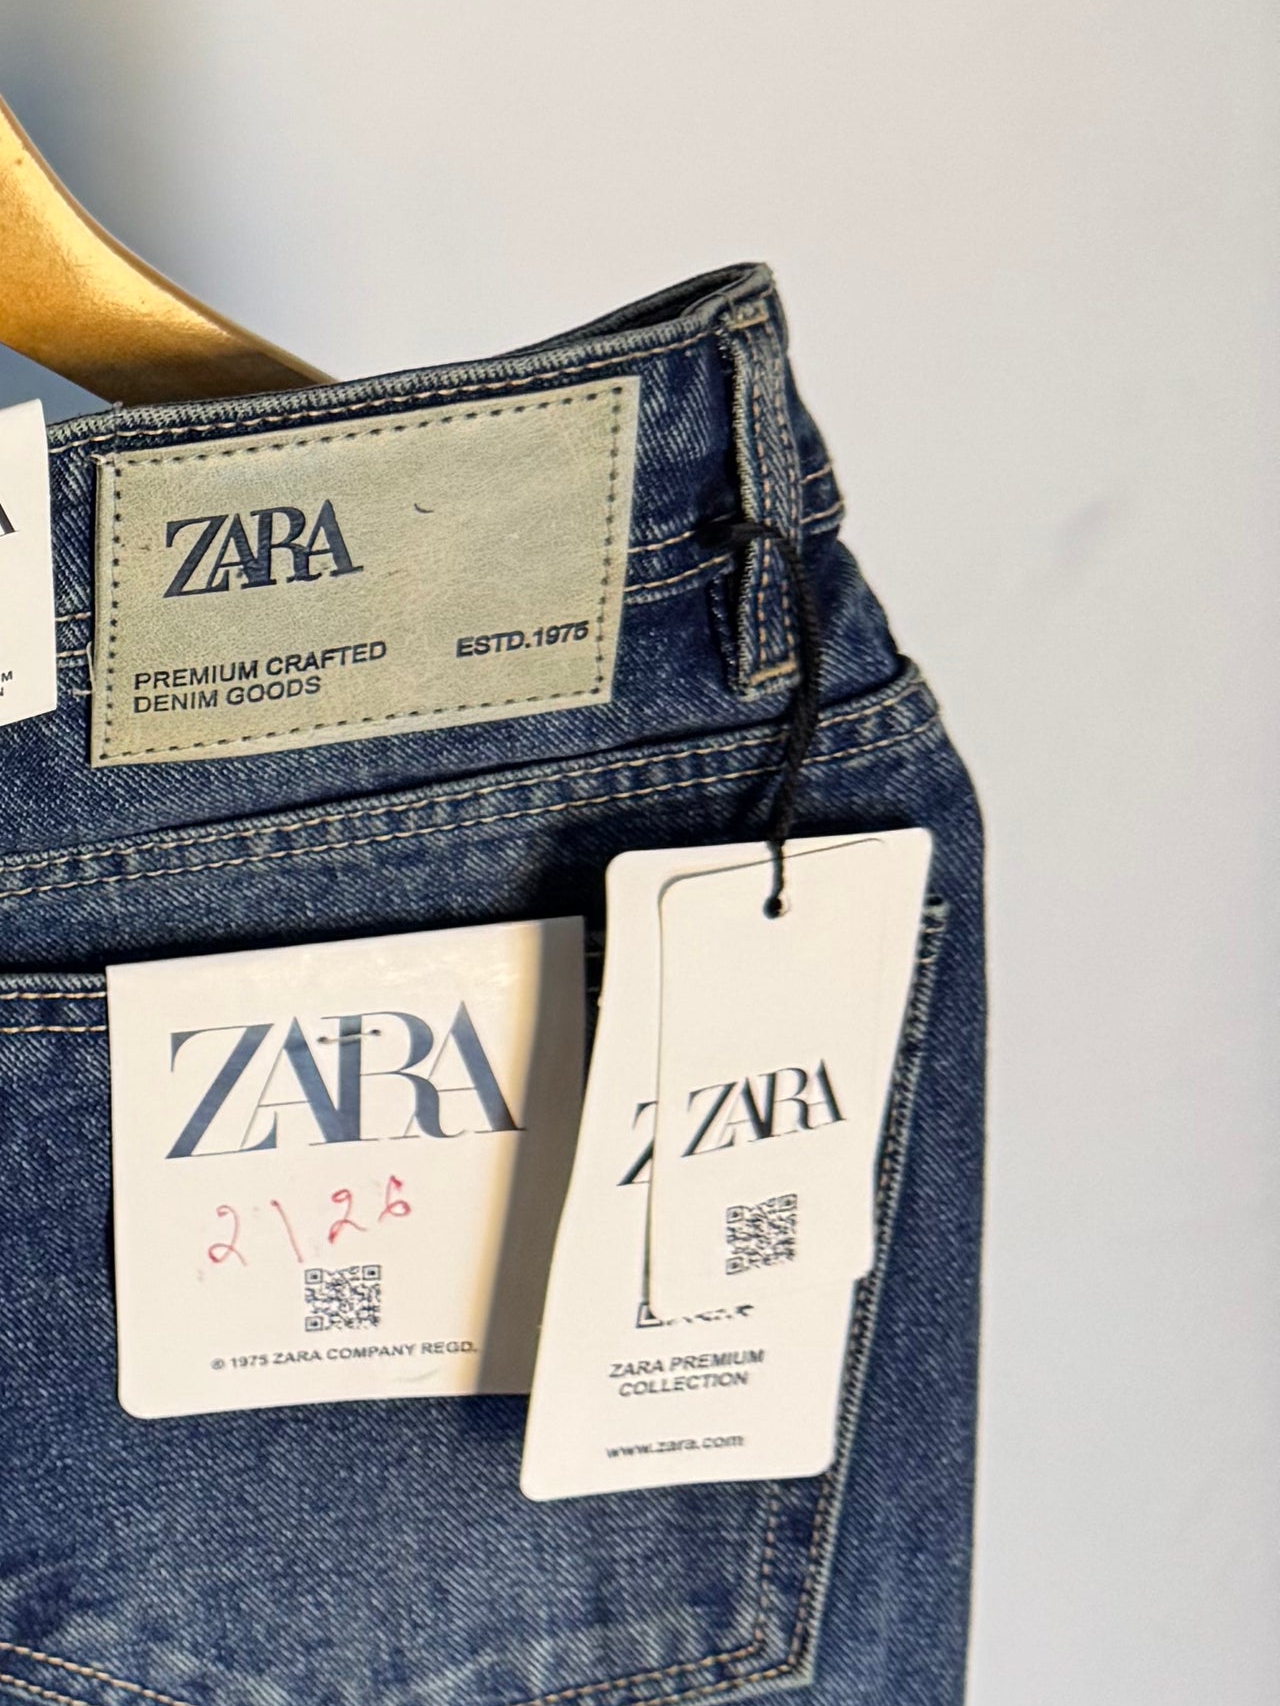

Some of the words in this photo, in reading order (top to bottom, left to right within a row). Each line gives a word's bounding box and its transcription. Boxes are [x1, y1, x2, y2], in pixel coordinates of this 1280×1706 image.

[162, 499, 365, 599] ZARA
[133, 659, 259, 690] PREMIUM
[265, 640, 388, 676] CRAFTED
[133, 688, 218, 713] DENIM
[226, 675, 322, 705] GOODS
[165, 999, 527, 1160] ZARA
[681, 1058, 847, 1158] ZARA
[230, 1352, 270, 1369] 1975
[273, 1348, 322, 1365] ZARA
[326, 1343, 417, 1361] COMPANY
[609, 1359, 665, 1379] ZARA
[669, 1349, 766, 1372] PREMIUM
[618, 1371, 749, 1398] COLLECTION
[606, 1435, 746, 1459] www.zara.com
